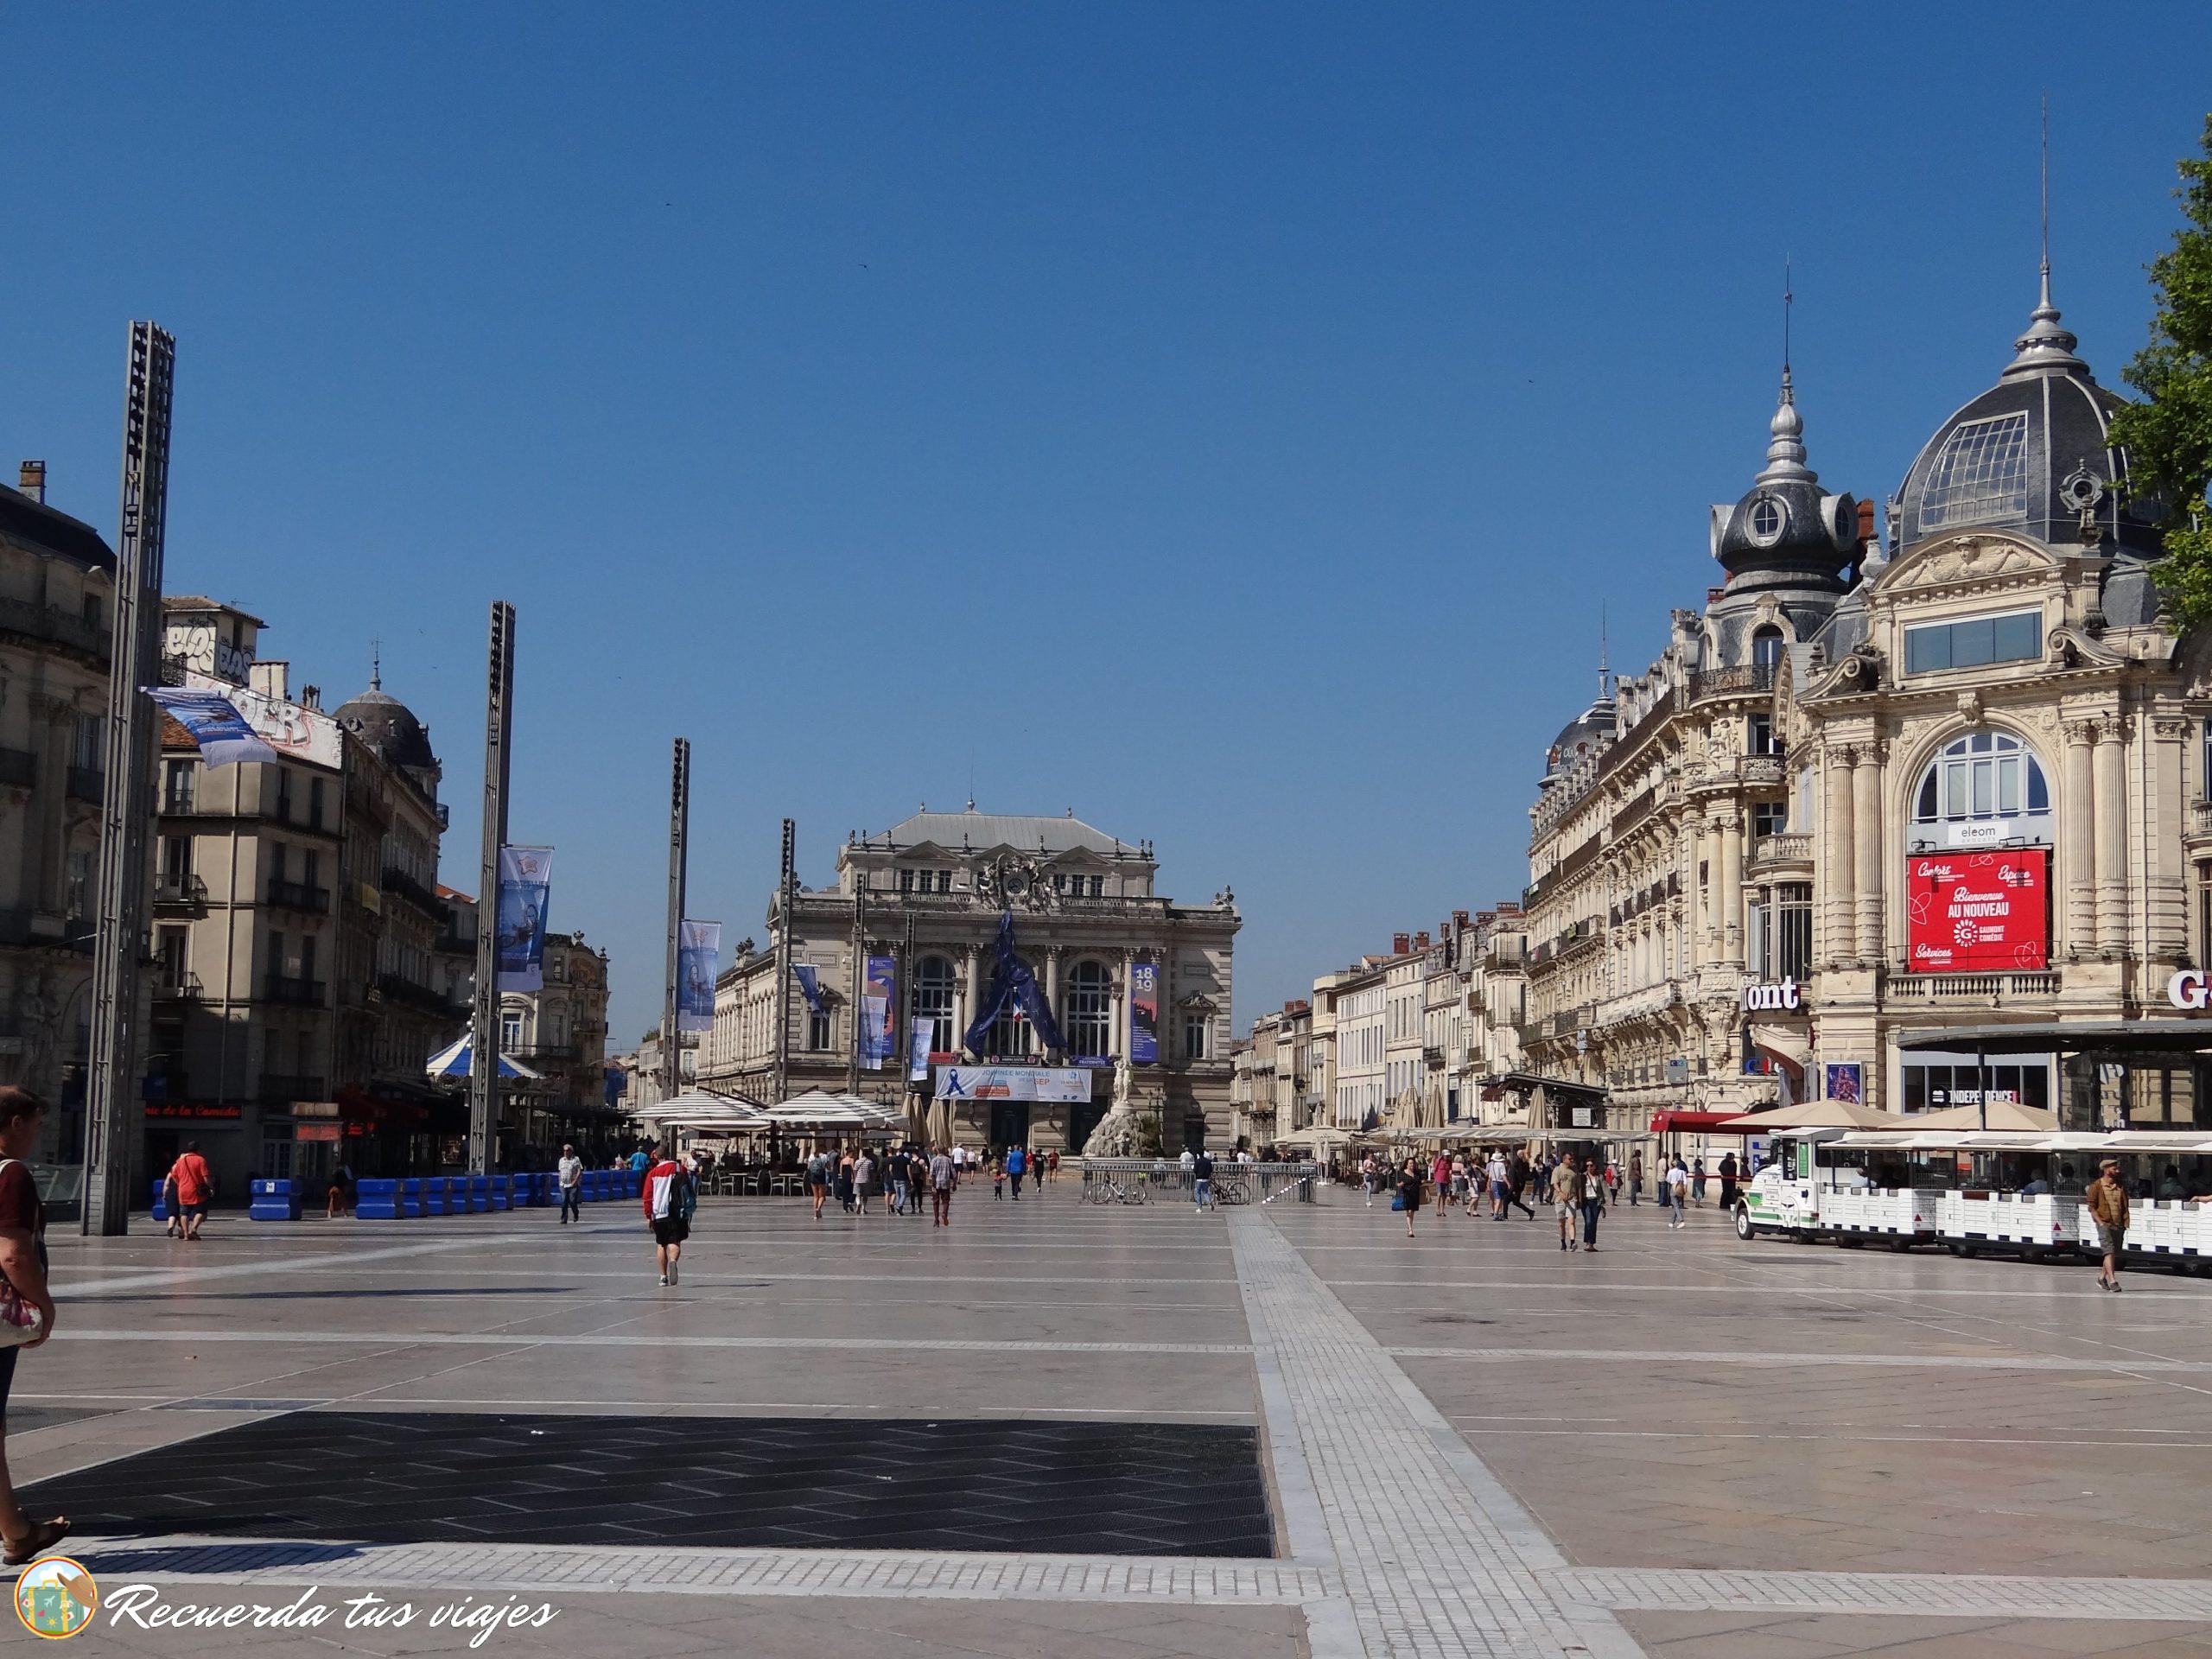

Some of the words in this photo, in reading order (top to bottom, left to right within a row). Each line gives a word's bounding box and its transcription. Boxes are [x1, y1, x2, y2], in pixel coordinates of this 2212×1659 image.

[1961, 825, 1996, 837] eleom
[1953, 887, 2005, 903] Bienvenue
[1948, 905, 1961, 918] AU
[1962, 902, 2010, 918] NOUVEAU
[1979, 925, 2005, 934] GAUMONT
[1979, 933, 2005, 942] COMÉDIE
[1915, 944, 1953, 958] Services
[1136, 967, 1154, 979] 18
[1136, 979, 1153, 992] 19
